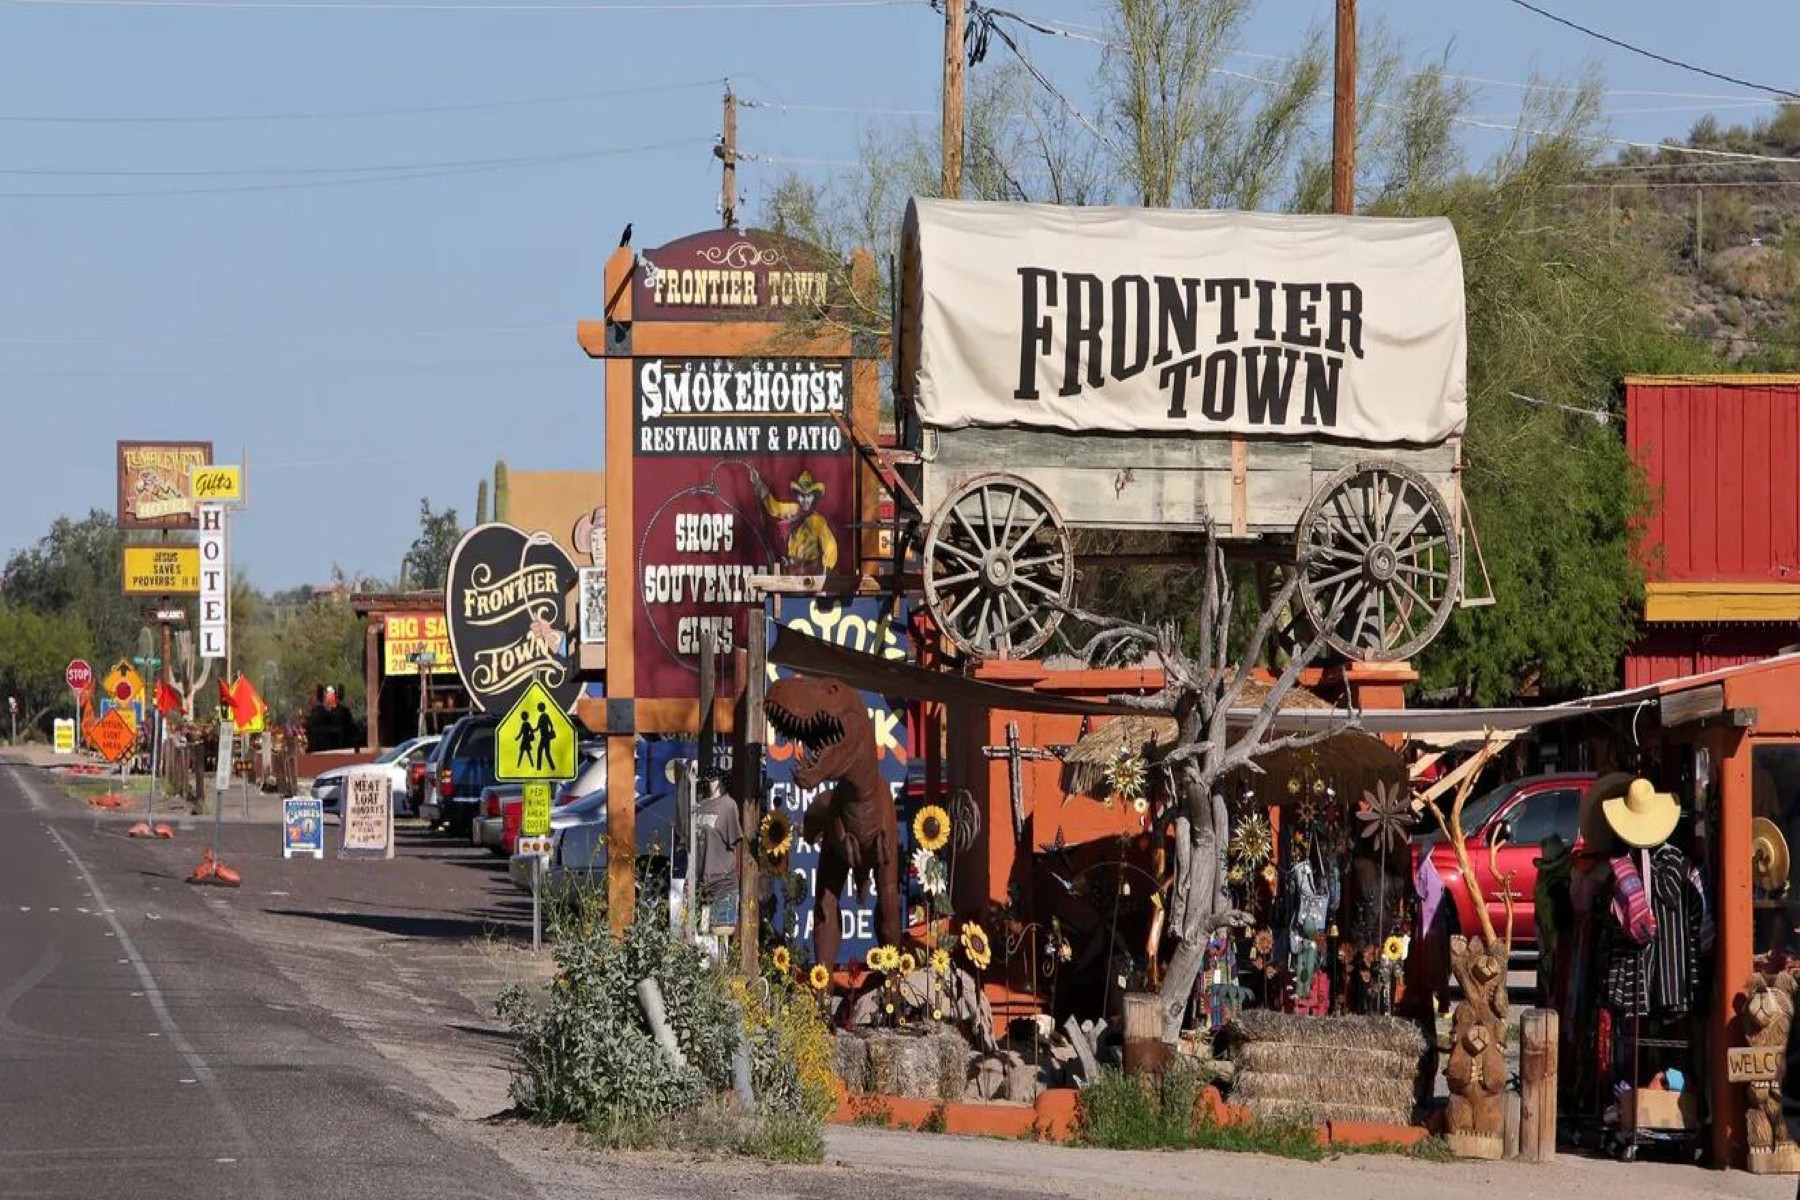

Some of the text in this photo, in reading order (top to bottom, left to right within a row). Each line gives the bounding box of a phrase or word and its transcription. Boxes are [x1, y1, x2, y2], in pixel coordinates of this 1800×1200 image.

[654, 269, 828, 305] FRONTIER TOWN
[1014, 267, 1364, 400] FRONTIER
[685, 361, 816, 372] CAVE CREEK
[641, 359, 844, 421] SMOKEHOUSE
[1159, 346, 1343, 426] TOWN
[641, 425, 841, 451] RESTAURANT & PATIO
[196, 473, 232, 496] Gifts
[676, 514, 734, 552] SHOPS
[153, 551, 178, 562] JESUS
[153, 563, 182, 575] SAVES
[132, 576, 176, 587] PROVERBS
[203, 511, 221, 653] HOTEL
[464, 570, 559, 617] FRONTIER
[388, 616, 419, 638] BIG
[474, 630, 550, 683] TOWN
[68, 669, 89, 680] STOP
[353, 780, 380, 792] MEAT
[355, 793, 379, 805] LOAF
